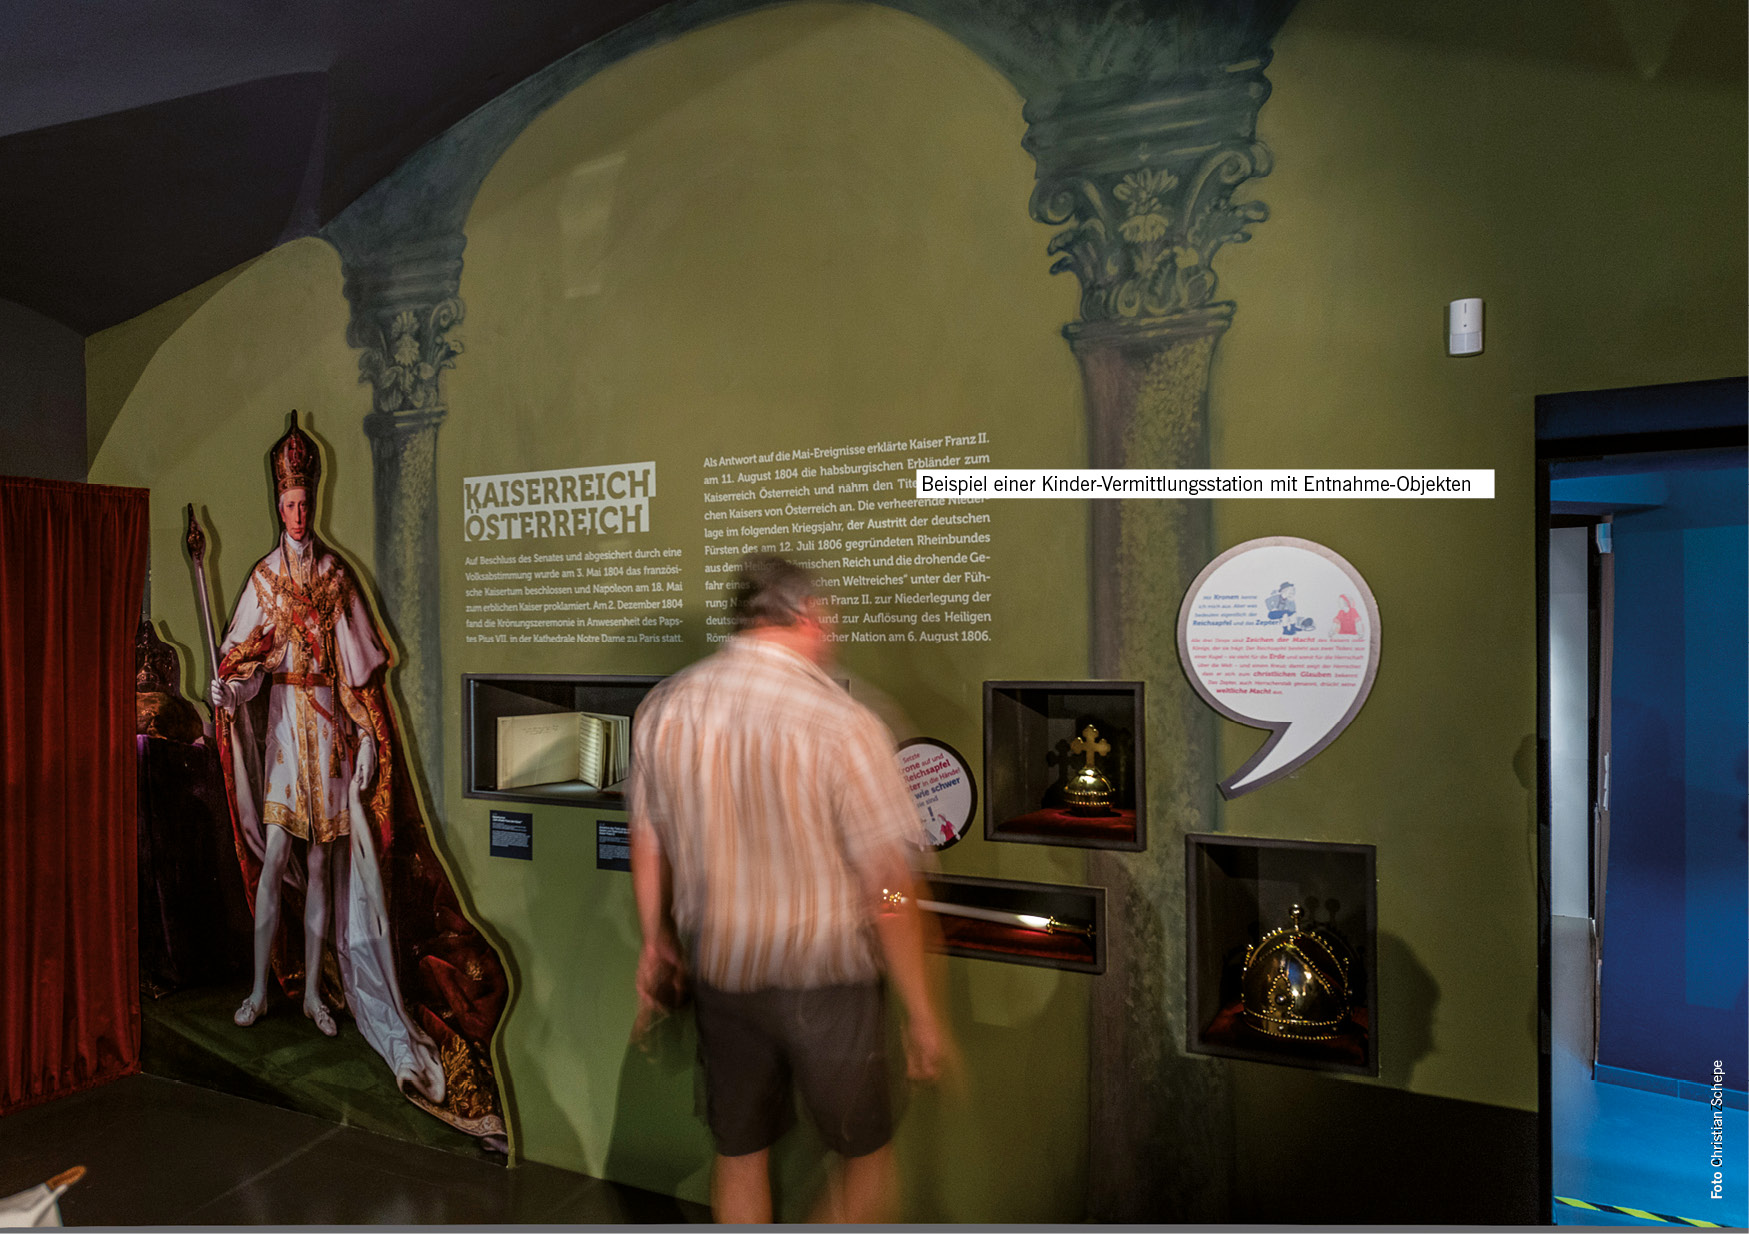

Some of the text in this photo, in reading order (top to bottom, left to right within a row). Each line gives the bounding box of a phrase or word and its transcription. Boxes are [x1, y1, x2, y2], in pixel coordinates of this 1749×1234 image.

[703, 434, 990, 469] Als Antwort auf die Mai-Ereignisse erklärte Kaiser Franz II.
[704, 456, 990, 486] am 11. August 1804 die habsburgischen Erbländer zum
[464, 469, 651, 510] KAISERREICH
[704, 489, 756, 504] Kaiserreich
[759, 485, 811, 500] Österreich
[814, 484, 835, 496] und
[873, 480, 894, 492] den
[704, 509, 728, 522] chen
[729, 507, 763, 520] Kaisers
[764, 509, 784, 518] von
[785, 503, 838, 517] Österreich
[839, 505, 856, 514] an.
[858, 501, 875, 513] Die
[465, 504, 643, 541] ÖSTERREICH
[704, 512, 991, 541] lage im folgenden Kriegsjahr, der Austritt der deutschen
[704, 532, 991, 556] Fürsten des am 12. Juli 1806 gegründeten Rheinbundes
[566, 552, 583, 562] und
[585, 550, 633, 564] abgesichert
[635, 548, 661, 559] durch
[663, 548, 682, 558] eine
[705, 566, 722, 574] aus
[722, 562, 743, 573] dem
[842, 557, 872, 569] Reich
[872, 556, 895, 568] und
[895, 556, 913, 567] die
[914, 554, 968, 567] drohende
[970, 553, 991, 565] Ge-
[577, 568, 584, 578] 3.
[587, 568, 602, 578] Mai
[604, 567, 624, 577] 1804
[626, 566, 642, 576] das
[644, 565, 683, 576] französi-
[574, 585, 592, 595] und
[593, 584, 634, 597] Napoleon
[652, 583, 664, 593] 18.
[667, 582, 683, 592] Mai
[705, 580, 725, 592] fahr
[910, 575, 941, 586] unter
[942, 573, 962, 585] der
[964, 572, 991, 584] Füh-
[593, 601, 608, 611] Am
[608, 601, 616, 610] 2.
[617, 600, 661, 610] Dezember
[662, 600, 684, 610] 1804
[706, 600, 728, 610] rung
[830, 595, 859, 606] Franz
[862, 594, 872, 606] II.
[875, 597, 893, 605] zur
[895, 592, 970, 607] Niederlegung
[972, 592, 992, 603] der
[577, 618, 586, 627] in
[587, 617, 641, 627] Anwesenheit
[642, 617, 658, 626] des
[659, 617, 684, 629] Paps-
[818, 611, 992, 626] und zur Auflösung des Heiligen
[577, 634, 600, 643] Notre
[601, 634, 626, 643] Dame
[639, 633, 661, 643] Paris
[662, 635, 684, 643] statt.
[851, 632, 887, 643] Nation
[888, 635, 906, 643] am
[908, 632, 917, 643] 6.
[919, 632, 959, 645] August
[962, 631, 992, 643] 1806.
[900, 762, 920, 774] rone
[931, 778, 960, 793] schwer
